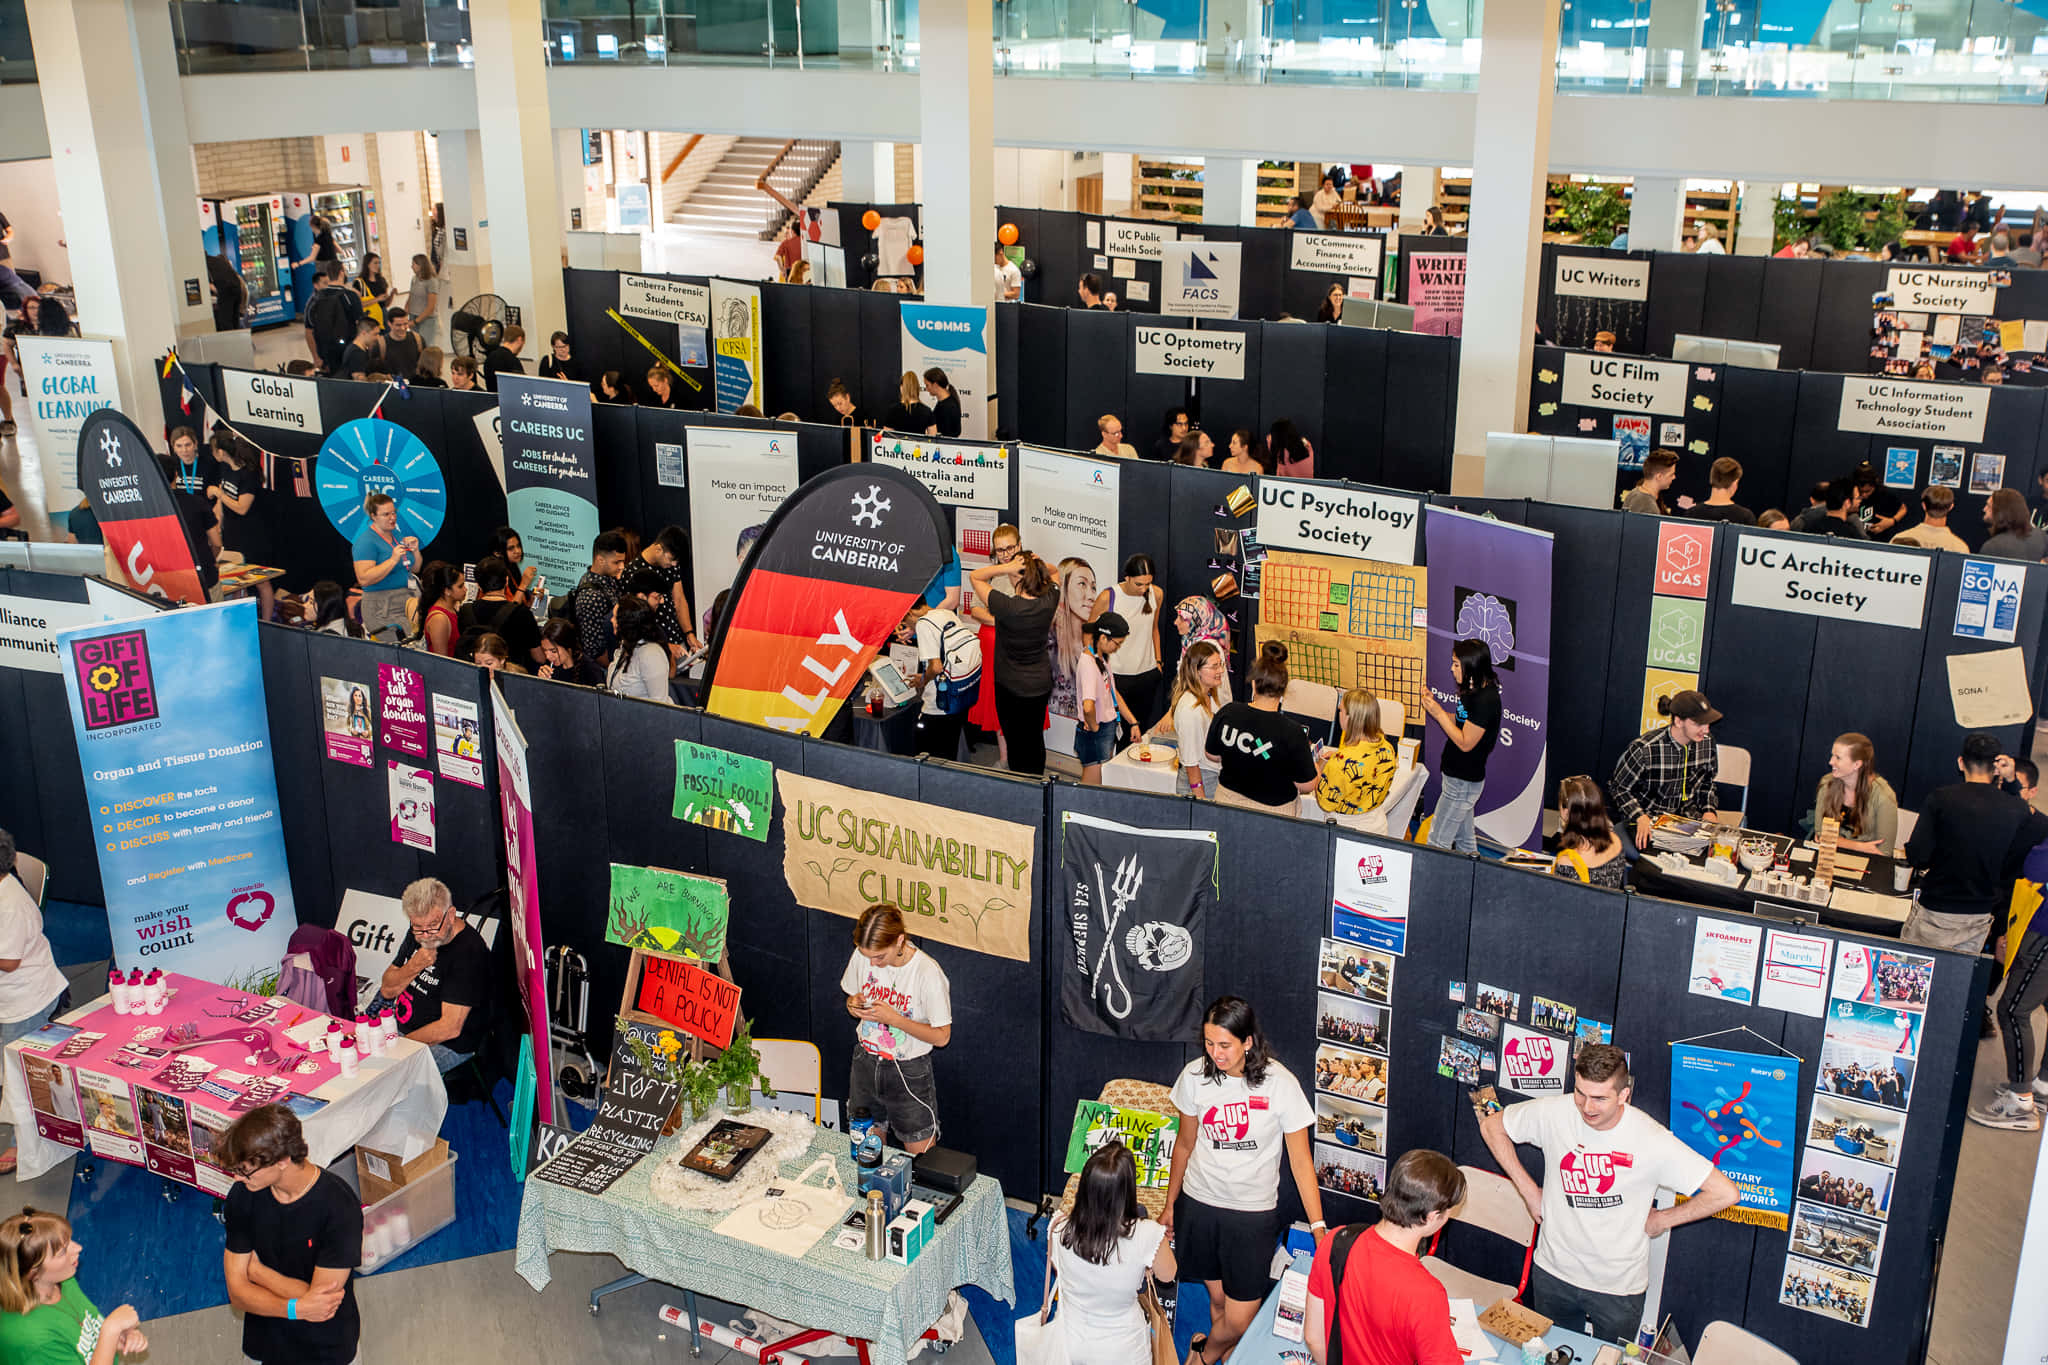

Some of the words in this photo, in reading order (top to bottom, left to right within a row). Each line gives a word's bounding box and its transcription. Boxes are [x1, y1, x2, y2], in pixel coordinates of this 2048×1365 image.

[1118, 229, 1132, 240] UC
[1134, 230, 1160, 242] Public
[1306, 237, 1319, 246] UC
[1109, 243, 1137, 255] Health
[1316, 249, 1346, 259] Finance
[1296, 259, 1341, 272] Accounting
[1343, 264, 1373, 274] Society
[627, 278, 666, 291] Canberra
[668, 284, 703, 297] Forensic
[1561, 269, 1584, 283] UC
[1587, 270, 1641, 288] Writers
[1899, 272, 1923, 286] UC
[1927, 273, 1987, 292] Nursing
[646, 293, 683, 307] Students
[1183, 288, 1219, 300] FACS
[1912, 292, 1967, 309] Society
[623, 304, 672, 320] Association
[674, 310, 706, 325] (CFSA)
[917, 320, 971, 332] UCOMMS
[722, 341, 746, 356] CFSA
[1138, 332, 1160, 346] UC
[1164, 333, 1242, 353] Optometry
[1164, 353, 1215, 371] Society
[1590, 359, 1617, 377] UC
[1623, 362, 1660, 381] Film
[42, 375, 100, 395] GLOBAL
[251, 378, 293, 398] Global
[1868, 385, 1888, 397] UC
[1891, 387, 1964, 403] Information
[533, 400, 568, 411] CANBERRA
[1591, 383, 1654, 408] Society
[247, 400, 304, 427] Learning
[1855, 400, 1921, 418] Technology
[1924, 404, 1973, 419] Student
[511, 420, 563, 438] CAREERS
[566, 427, 585, 441] UC
[1615, 418, 1649, 430] JAWS
[1876, 417, 1946, 432] Association
[521, 449, 541, 460] JOBS
[513, 460, 547, 474] CAREERS
[711, 479, 736, 490] Make
[753, 482, 786, 493] impact
[954, 473, 974, 484] and
[725, 492, 737, 500] on
[739, 493, 755, 501] our
[757, 492, 785, 502] future
[929, 485, 974, 500] Zealand
[1044, 505, 1065, 518] Make
[1068, 513, 1079, 521] an
[1080, 514, 1106, 527] impact
[1262, 486, 1295, 508] UC
[1301, 492, 1415, 529] Psychology
[1031, 516, 1042, 524] on
[1044, 517, 1057, 527] our
[1058, 521, 1107, 539] communities
[1298, 520, 1372, 551] Society
[815, 530, 885, 553] UNIVERSITY
[887, 542, 905, 555] OF
[811, 545, 899, 573] CANBERRA
[1740, 547, 1776, 567] UC
[1781, 552, 1922, 585] Architecture
[1661, 571, 1701, 586] UCAS
[1964, 575, 2018, 594] SONA
[1785, 581, 1867, 611] Society
[80, 637, 139, 664] GIFT
[1653, 648, 1696, 665] UCAS
[392, 668, 413, 685] let's
[387, 682, 408, 696] talk
[88, 688, 149, 725] LIFE
[382, 705, 426, 723] donation
[385, 696, 414, 712] organ
[1503, 708, 1541, 730] Society
[86, 722, 161, 741] INCORPORATED
[93, 766, 133, 781] Organ
[137, 761, 161, 774] and
[164, 752, 205, 767] Tissue
[208, 739, 263, 759] Donation
[726, 752, 740, 769] be
[718, 766, 725, 776] a
[114, 792, 175, 814] DISCOVER
[177, 790, 192, 801] the
[195, 784, 217, 797] facts
[683, 774, 725, 799] FOSSIL
[731, 783, 768, 813] FOOL!
[117, 814, 161, 832] DECIDE
[164, 811, 174, 822] to
[176, 804, 215, 820] become
[219, 803, 225, 811] a
[228, 796, 255, 809] donor
[120, 831, 170, 850] DISCUSS
[173, 826, 192, 839] with
[194, 820, 222, 837] family
[225, 815, 243, 828] and
[246, 809, 273, 824] friends
[797, 799, 833, 844] UC
[836, 808, 1028, 890] SUSTAINABILITY
[127, 875, 147, 887] and
[148, 866, 185, 882] Register
[187, 861, 206, 872] with
[208, 852, 253, 867] Medicare
[626, 886, 641, 903] WE
[657, 881, 675, 894] ARE
[681, 887, 713, 921] BURNING
[859, 869, 948, 924] CLUB!
[1073, 882, 1089, 907] SEA
[134, 911, 163, 924] make
[166, 903, 189, 917] your
[136, 915, 192, 941] wish
[348, 920, 395, 954] Gift
[140, 932, 194, 957] count
[1780, 950, 1812, 963] March
[647, 956, 695, 994] DENIAL
[699, 974, 711, 1001] IS
[713, 983, 740, 1013] NOT
[654, 985, 664, 1011] A
[1529, 1039, 1552, 1061] UC
[1505, 1054, 1532, 1075] RC
[1751, 1068, 1771, 1078] Rotary
[599, 1101, 665, 1131] PLASTIC
[1081, 1105, 1157, 1134] NOTHING
[1226, 1103, 1247, 1126] UC
[588, 1124, 654, 1152] RECYCLING
[1204, 1122, 1228, 1140] RC
[1585, 1155, 1612, 1177] UC
[1561, 1169, 1587, 1192] RC
[1722, 1170, 1763, 1185] ROTARY
[1740, 1192, 1778, 1207] WORLD
